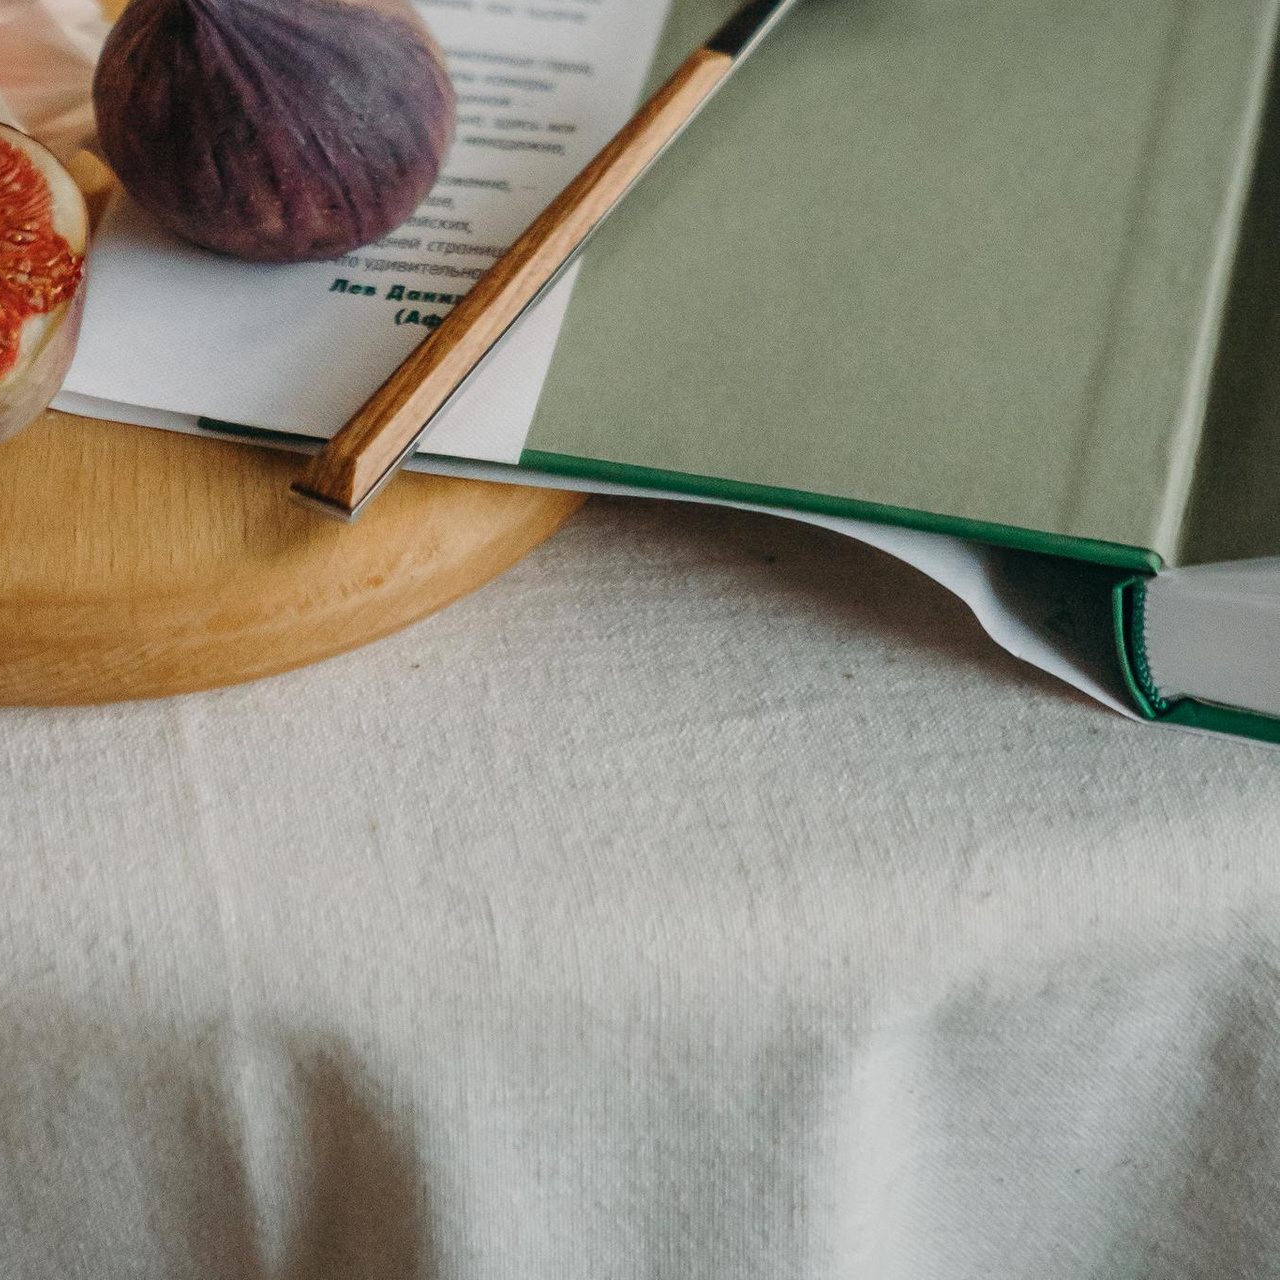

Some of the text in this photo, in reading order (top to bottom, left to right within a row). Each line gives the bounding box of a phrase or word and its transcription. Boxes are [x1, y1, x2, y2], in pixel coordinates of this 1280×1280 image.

[426, 240, 507, 258] страниц
[329, 278, 378, 296] Лев
[394, 307, 444, 330] (Аф
